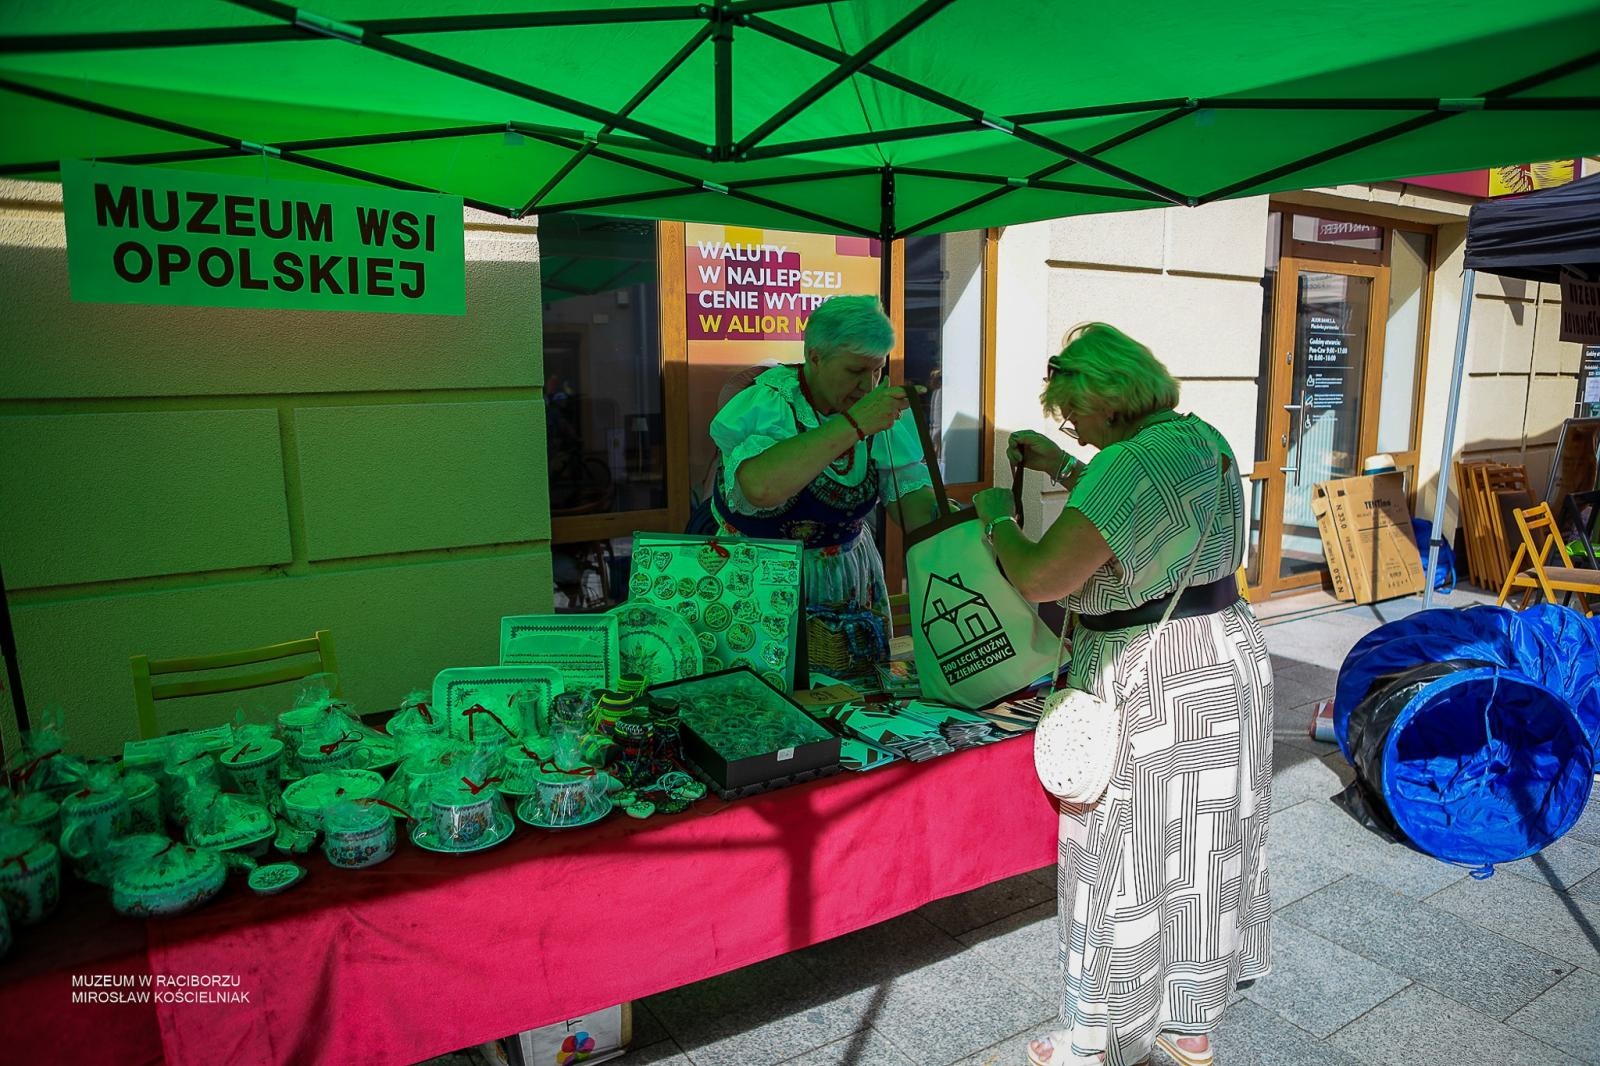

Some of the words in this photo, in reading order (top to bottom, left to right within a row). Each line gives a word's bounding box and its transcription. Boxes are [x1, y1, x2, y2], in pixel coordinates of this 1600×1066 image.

[94, 183, 333, 242] MUZEUM
[355, 205, 436, 253] WSI
[698, 240, 788, 263] WALUTY
[112, 240, 427, 300] OPOLSKIEJ
[698, 265, 721, 284] W
[727, 266, 842, 289] NAJLEPSZEJ
[698, 289, 759, 310] CENIE
[699, 314, 722, 333] W
[727, 314, 790, 334] ALIOR
[942, 662, 957, 673] 300
[957, 650, 979, 666] LECIE
[947, 674, 955, 683] Z
[954, 646, 1013, 680] ZIEMIEŁOWIC
